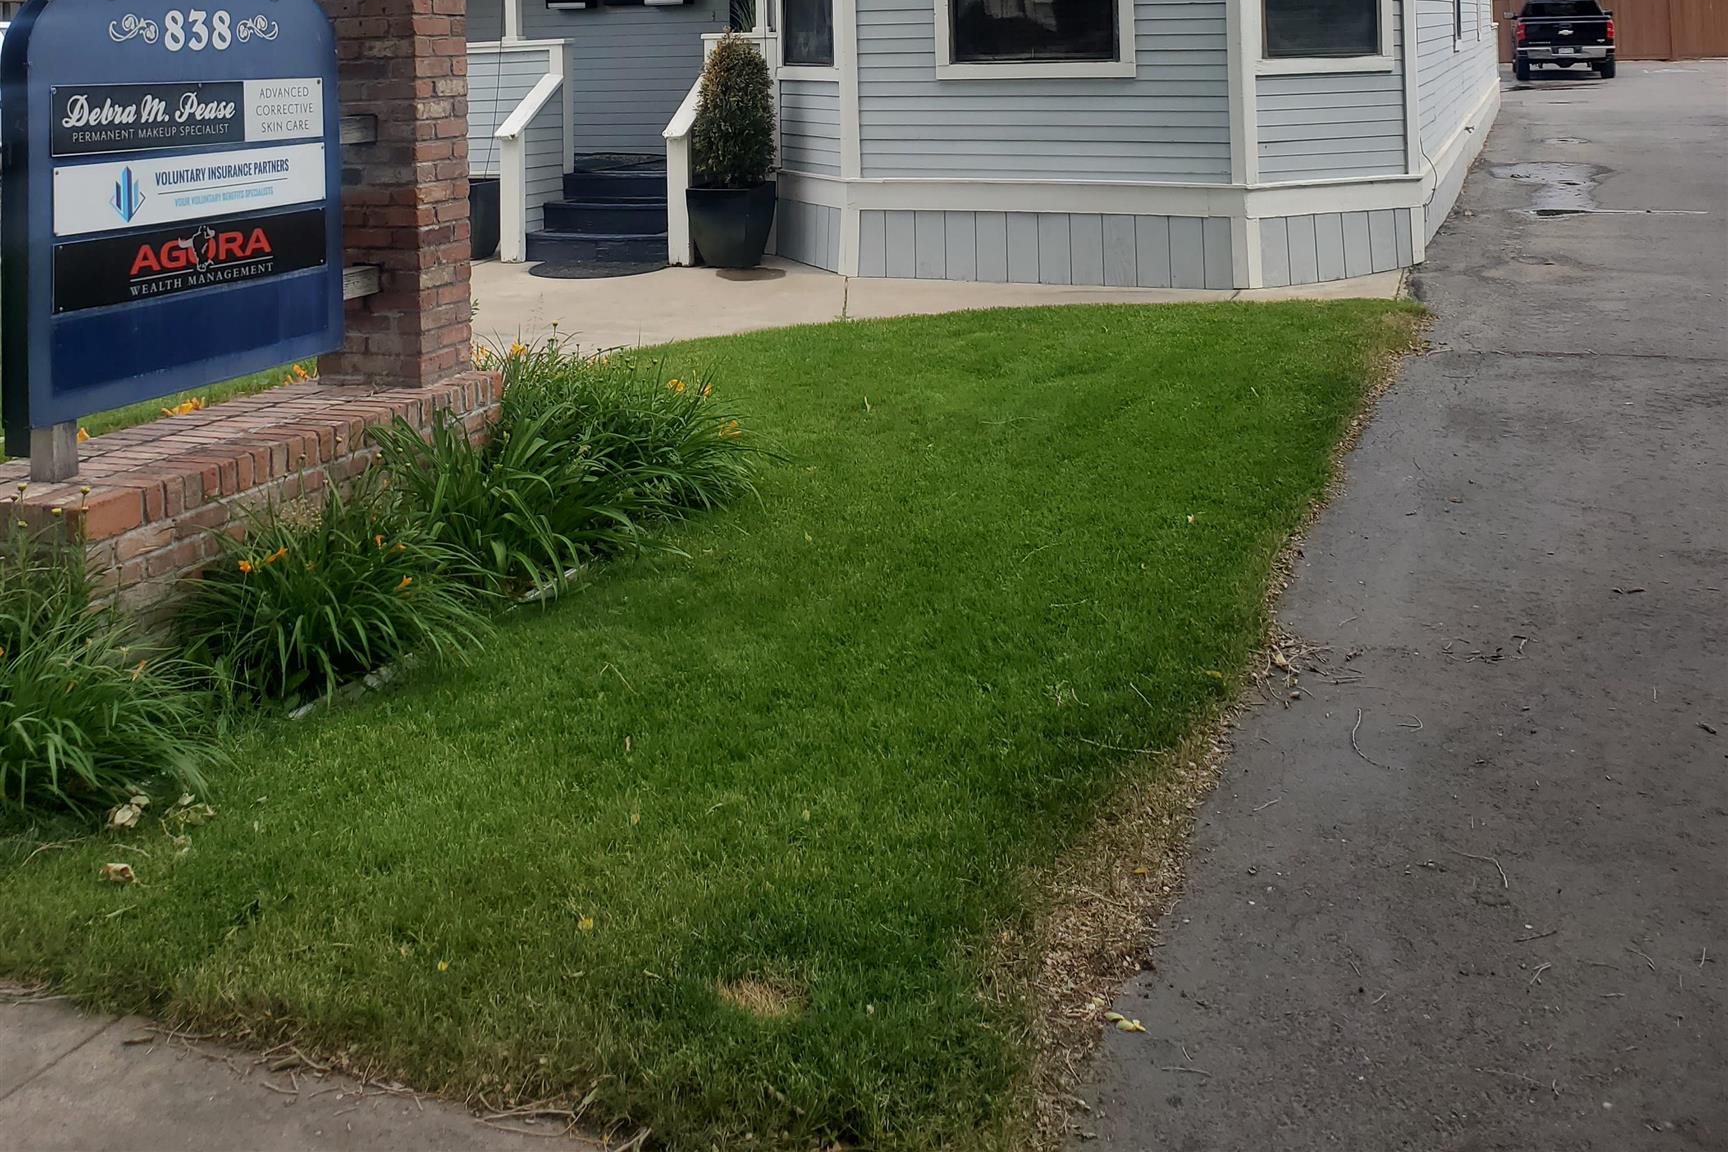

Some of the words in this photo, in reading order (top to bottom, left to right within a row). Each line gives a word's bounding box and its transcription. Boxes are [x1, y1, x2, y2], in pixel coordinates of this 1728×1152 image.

[164, 9, 232, 51] 838
[259, 87, 310, 99] ADVANCED
[62, 94, 138, 128] Debra
[140, 94, 170, 123] M.
[175, 92, 236, 122] Pease
[255, 103, 313, 117] CORRECTIVE
[72, 129, 135, 143] PERMANENT
[138, 126, 177, 138] MAKEUP
[180, 123, 230, 137] SPECIALIST
[261, 121, 283, 133] SKIN
[286, 119, 310, 131] CARE
[155, 168, 206, 186] VOLUNTARY
[208, 163, 253, 180] INSURANCE
[253, 158, 289, 175] PARTNERS
[130, 279, 183, 296] WEALTH
[188, 262, 274, 286] MANAGEMENT
